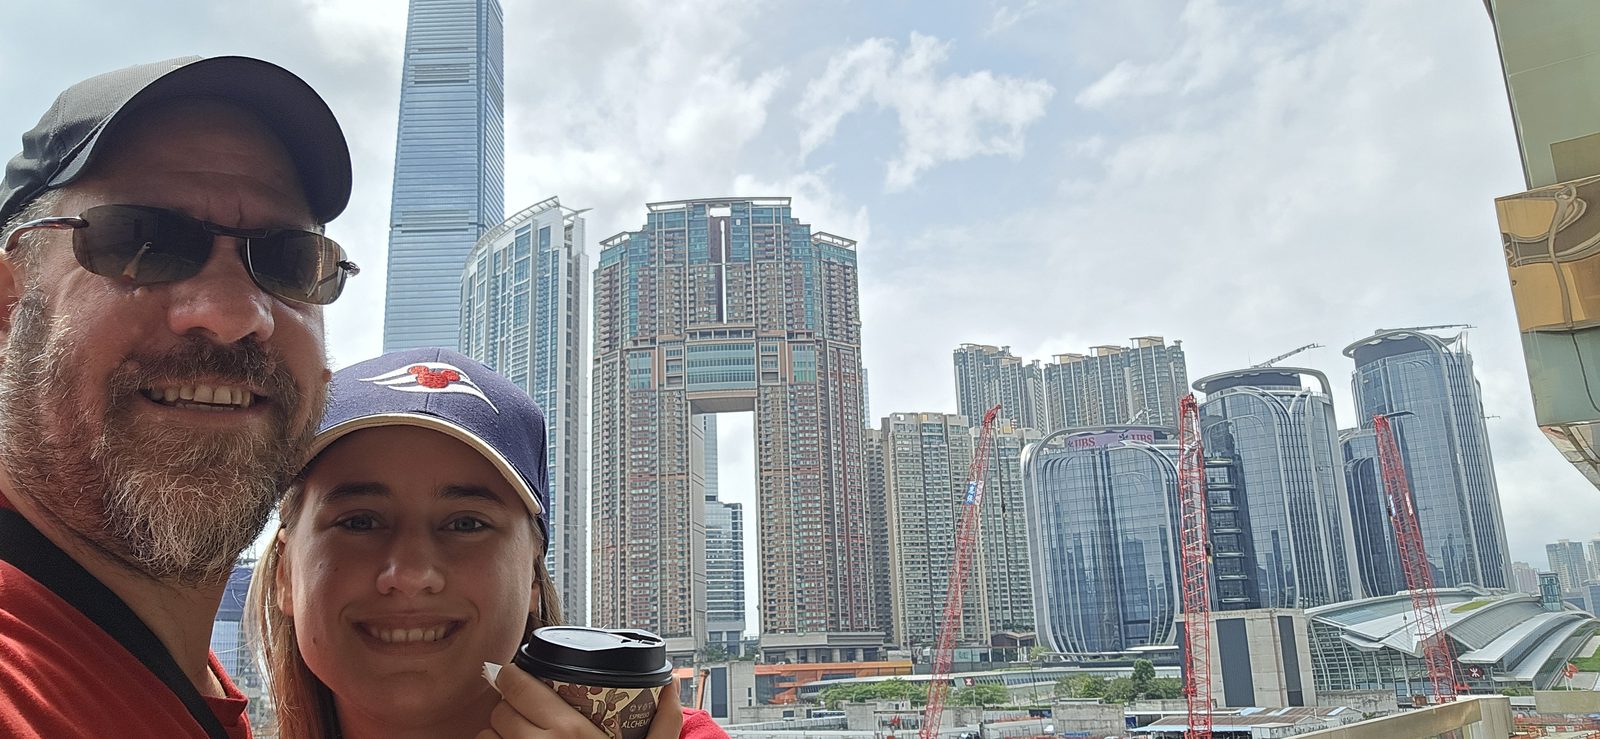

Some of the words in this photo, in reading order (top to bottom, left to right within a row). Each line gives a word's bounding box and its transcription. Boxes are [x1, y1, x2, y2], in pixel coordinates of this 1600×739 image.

[1074, 438, 1096, 448] UBS
[1131, 434, 1153, 443] UBS
[621, 719, 650, 729] ALCHEM
